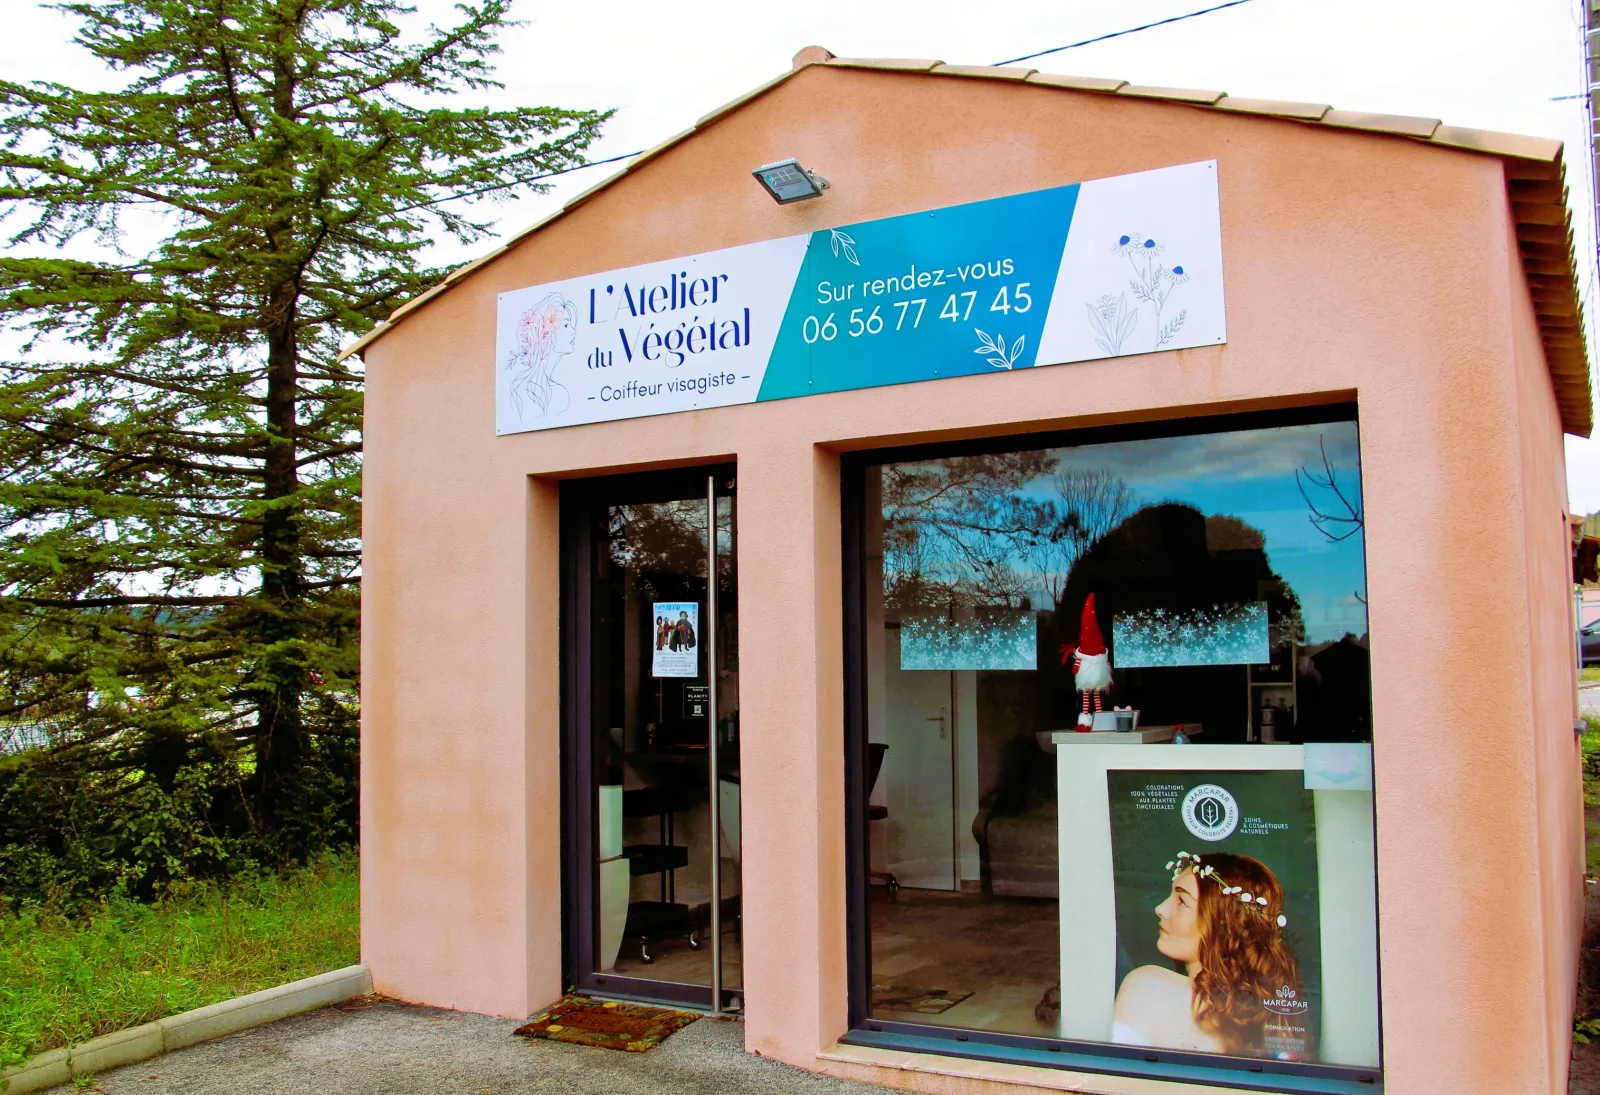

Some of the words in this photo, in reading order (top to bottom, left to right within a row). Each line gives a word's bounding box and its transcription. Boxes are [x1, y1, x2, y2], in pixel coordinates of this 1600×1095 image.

[817, 281, 855, 304] Sur
[863, 258, 1015, 297] rendez-vous
[590, 271, 728, 324] L'Atelier
[802, 312, 838, 344] 06
[848, 305, 884, 337] 56
[893, 298, 927, 331] 77
[939, 290, 977, 322] 47
[990, 282, 1032, 315] 45
[587, 347, 613, 369] du
[619, 307, 750, 368] Végétal
[600, 380, 662, 401] Coiffeur
[667, 371, 736, 394] visagiste
[1189, 787, 1230, 803] MARCAPAR
[1198, 828, 1227, 837] COLORISTE
[1248, 822, 1289, 830] COSMÉTIQUES
[1263, 999, 1308, 1008] MARCAPAR
[1265, 1024, 1305, 1032] FORMULATION
